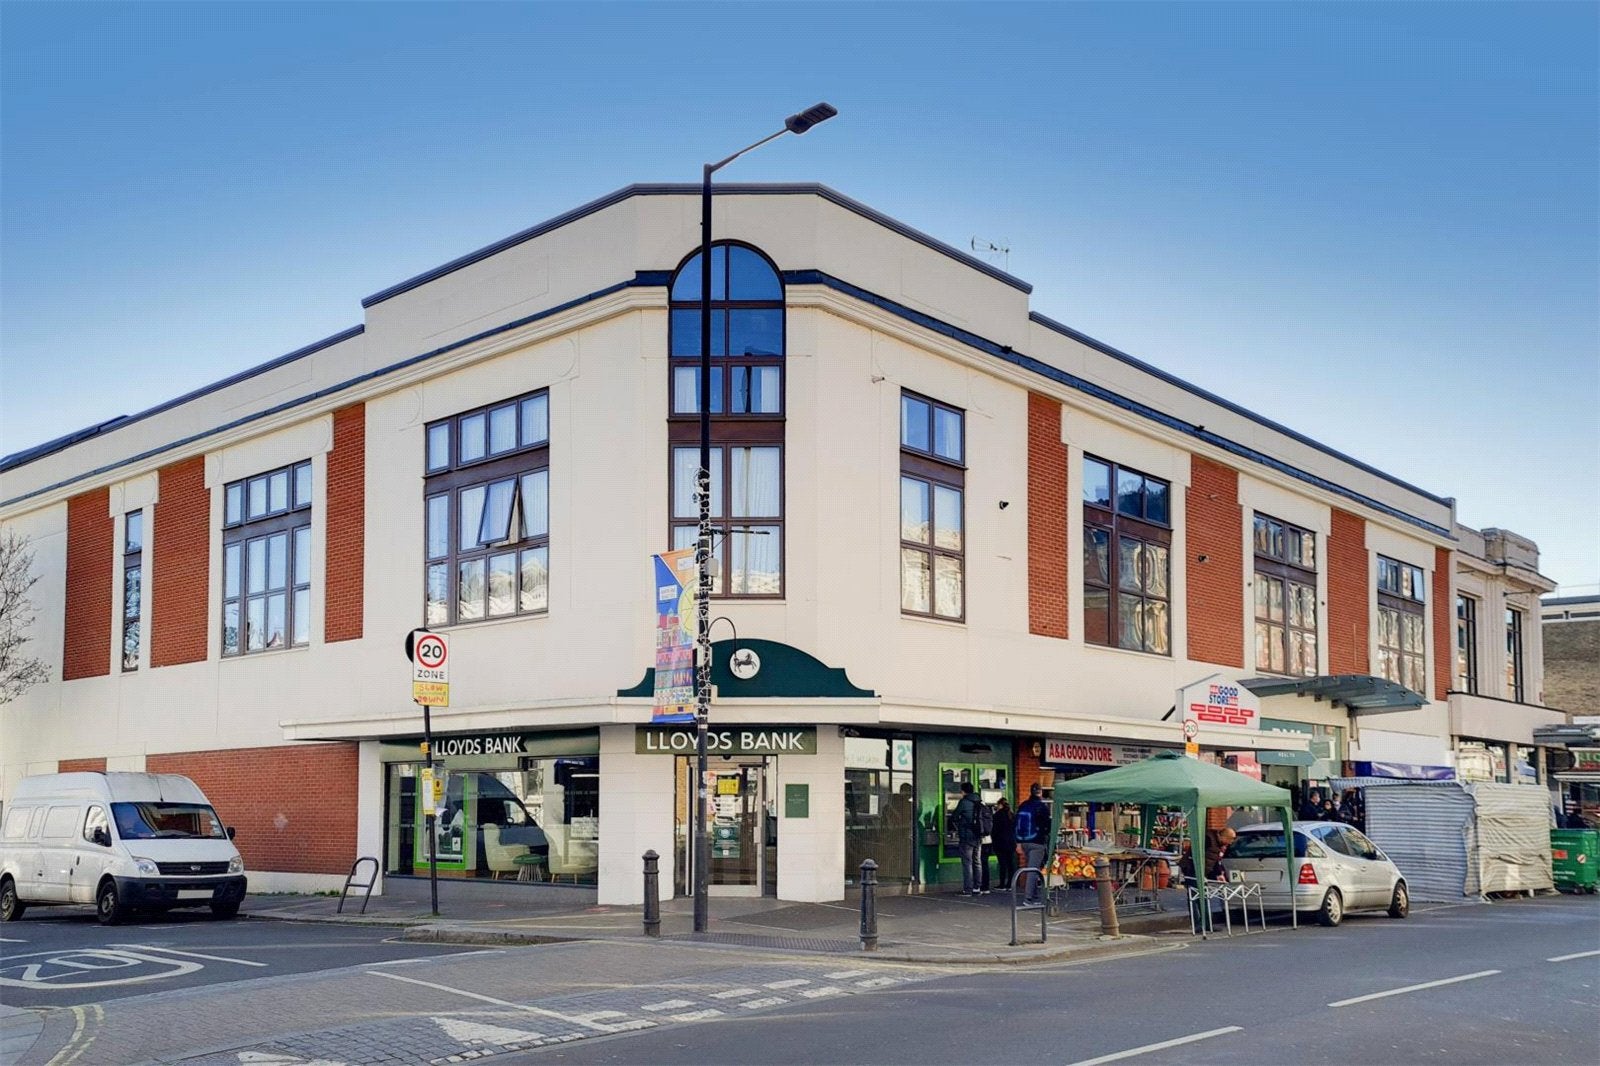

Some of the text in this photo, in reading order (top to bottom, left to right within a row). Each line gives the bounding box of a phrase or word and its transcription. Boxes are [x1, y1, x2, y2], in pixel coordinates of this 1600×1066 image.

[422, 644, 442, 658] 20
[417, 669, 445, 679] ZONE
[1218, 685, 1238, 697] GOOD
[1209, 694, 1229, 705] STORE
[435, 735, 521, 756] LLOYDS BANK
[740, 732, 804, 749] BANK
[1049, 743, 1065, 758] A&A
[1066, 744, 1088, 760] GOOD
[1089, 746, 1112, 761] STORE
